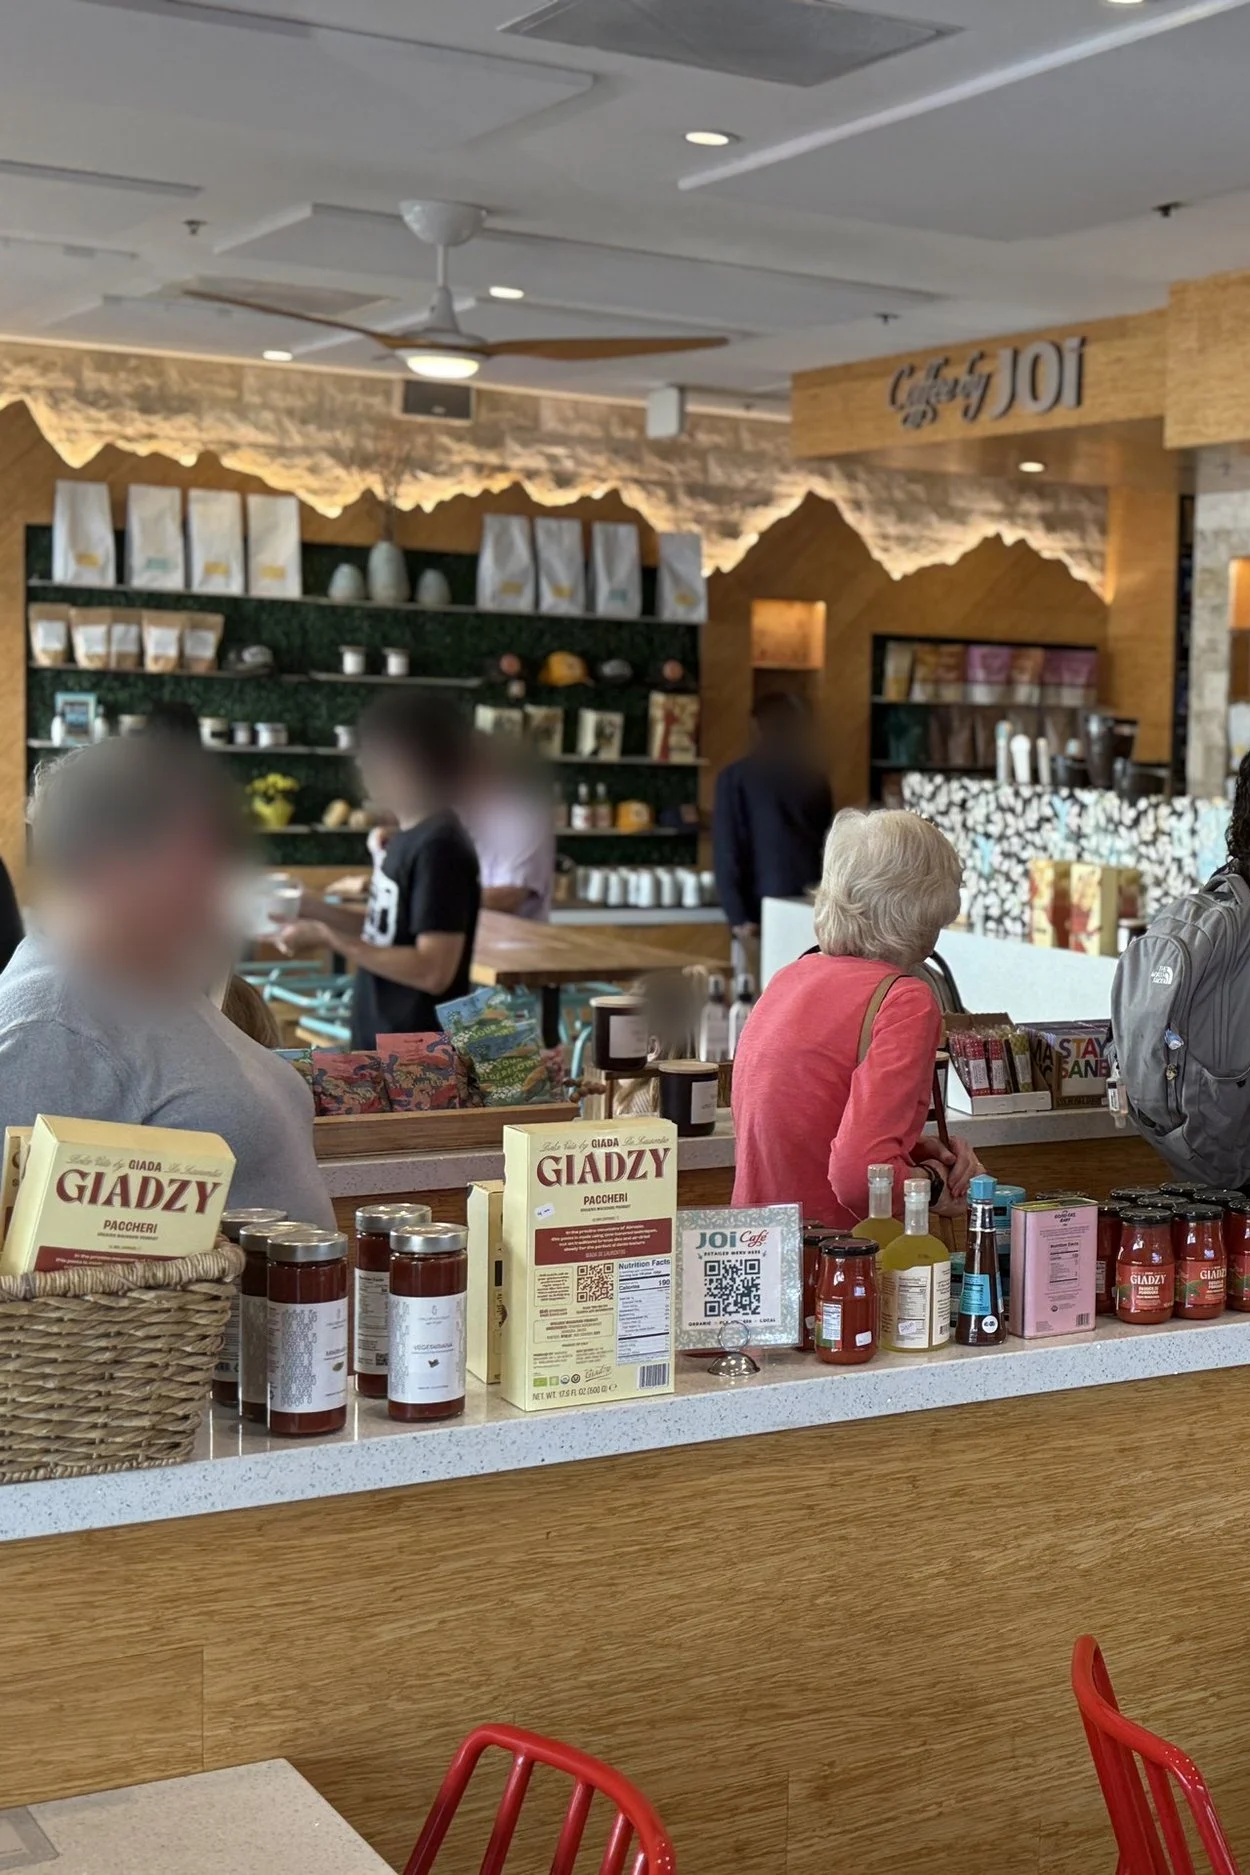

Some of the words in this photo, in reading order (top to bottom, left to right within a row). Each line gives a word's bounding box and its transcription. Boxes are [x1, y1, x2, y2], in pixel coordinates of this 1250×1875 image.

[1059, 1037, 1107, 1059] STAY
[591, 1138, 619, 1149] GIADA
[128, 1159, 162, 1173] GIADA
[536, 1147, 672, 1187] GIADZY
[56, 1168, 223, 1214] GIADZY
[583, 1192, 628, 1206] PACCHERI
[103, 1219, 158, 1234] PACCHERI
[739, 1229, 769, 1248] Café
[618, 1260, 650, 1270] Nutrition
[651, 1258, 671, 1267] Facts
[1130, 1274, 1167, 1285] GIADZY
